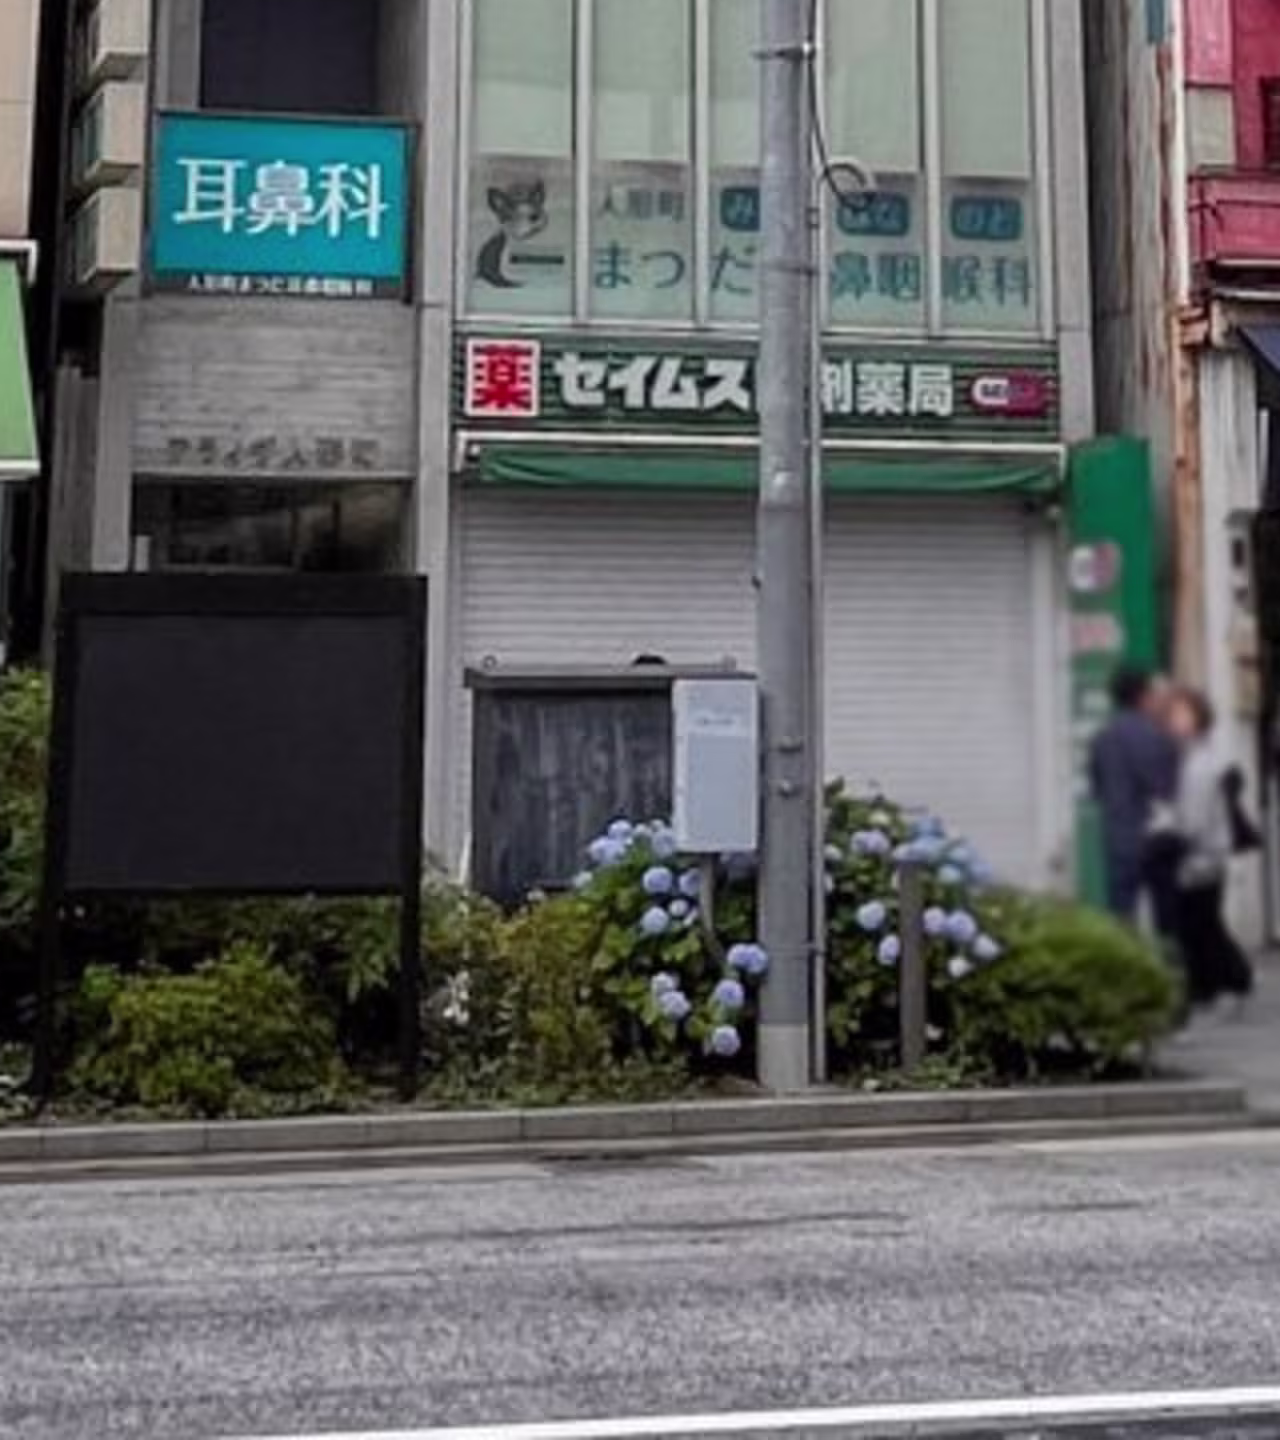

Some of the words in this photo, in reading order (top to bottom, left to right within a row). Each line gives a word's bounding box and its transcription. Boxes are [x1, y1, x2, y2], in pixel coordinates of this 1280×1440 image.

[172, 157, 390, 239] 耳鼻科
[594, 242, 1033, 308] まつだ鼻咽喉科
[472, 342, 534, 413] 薬
[554, 351, 955, 417] セイムス剤薬局
